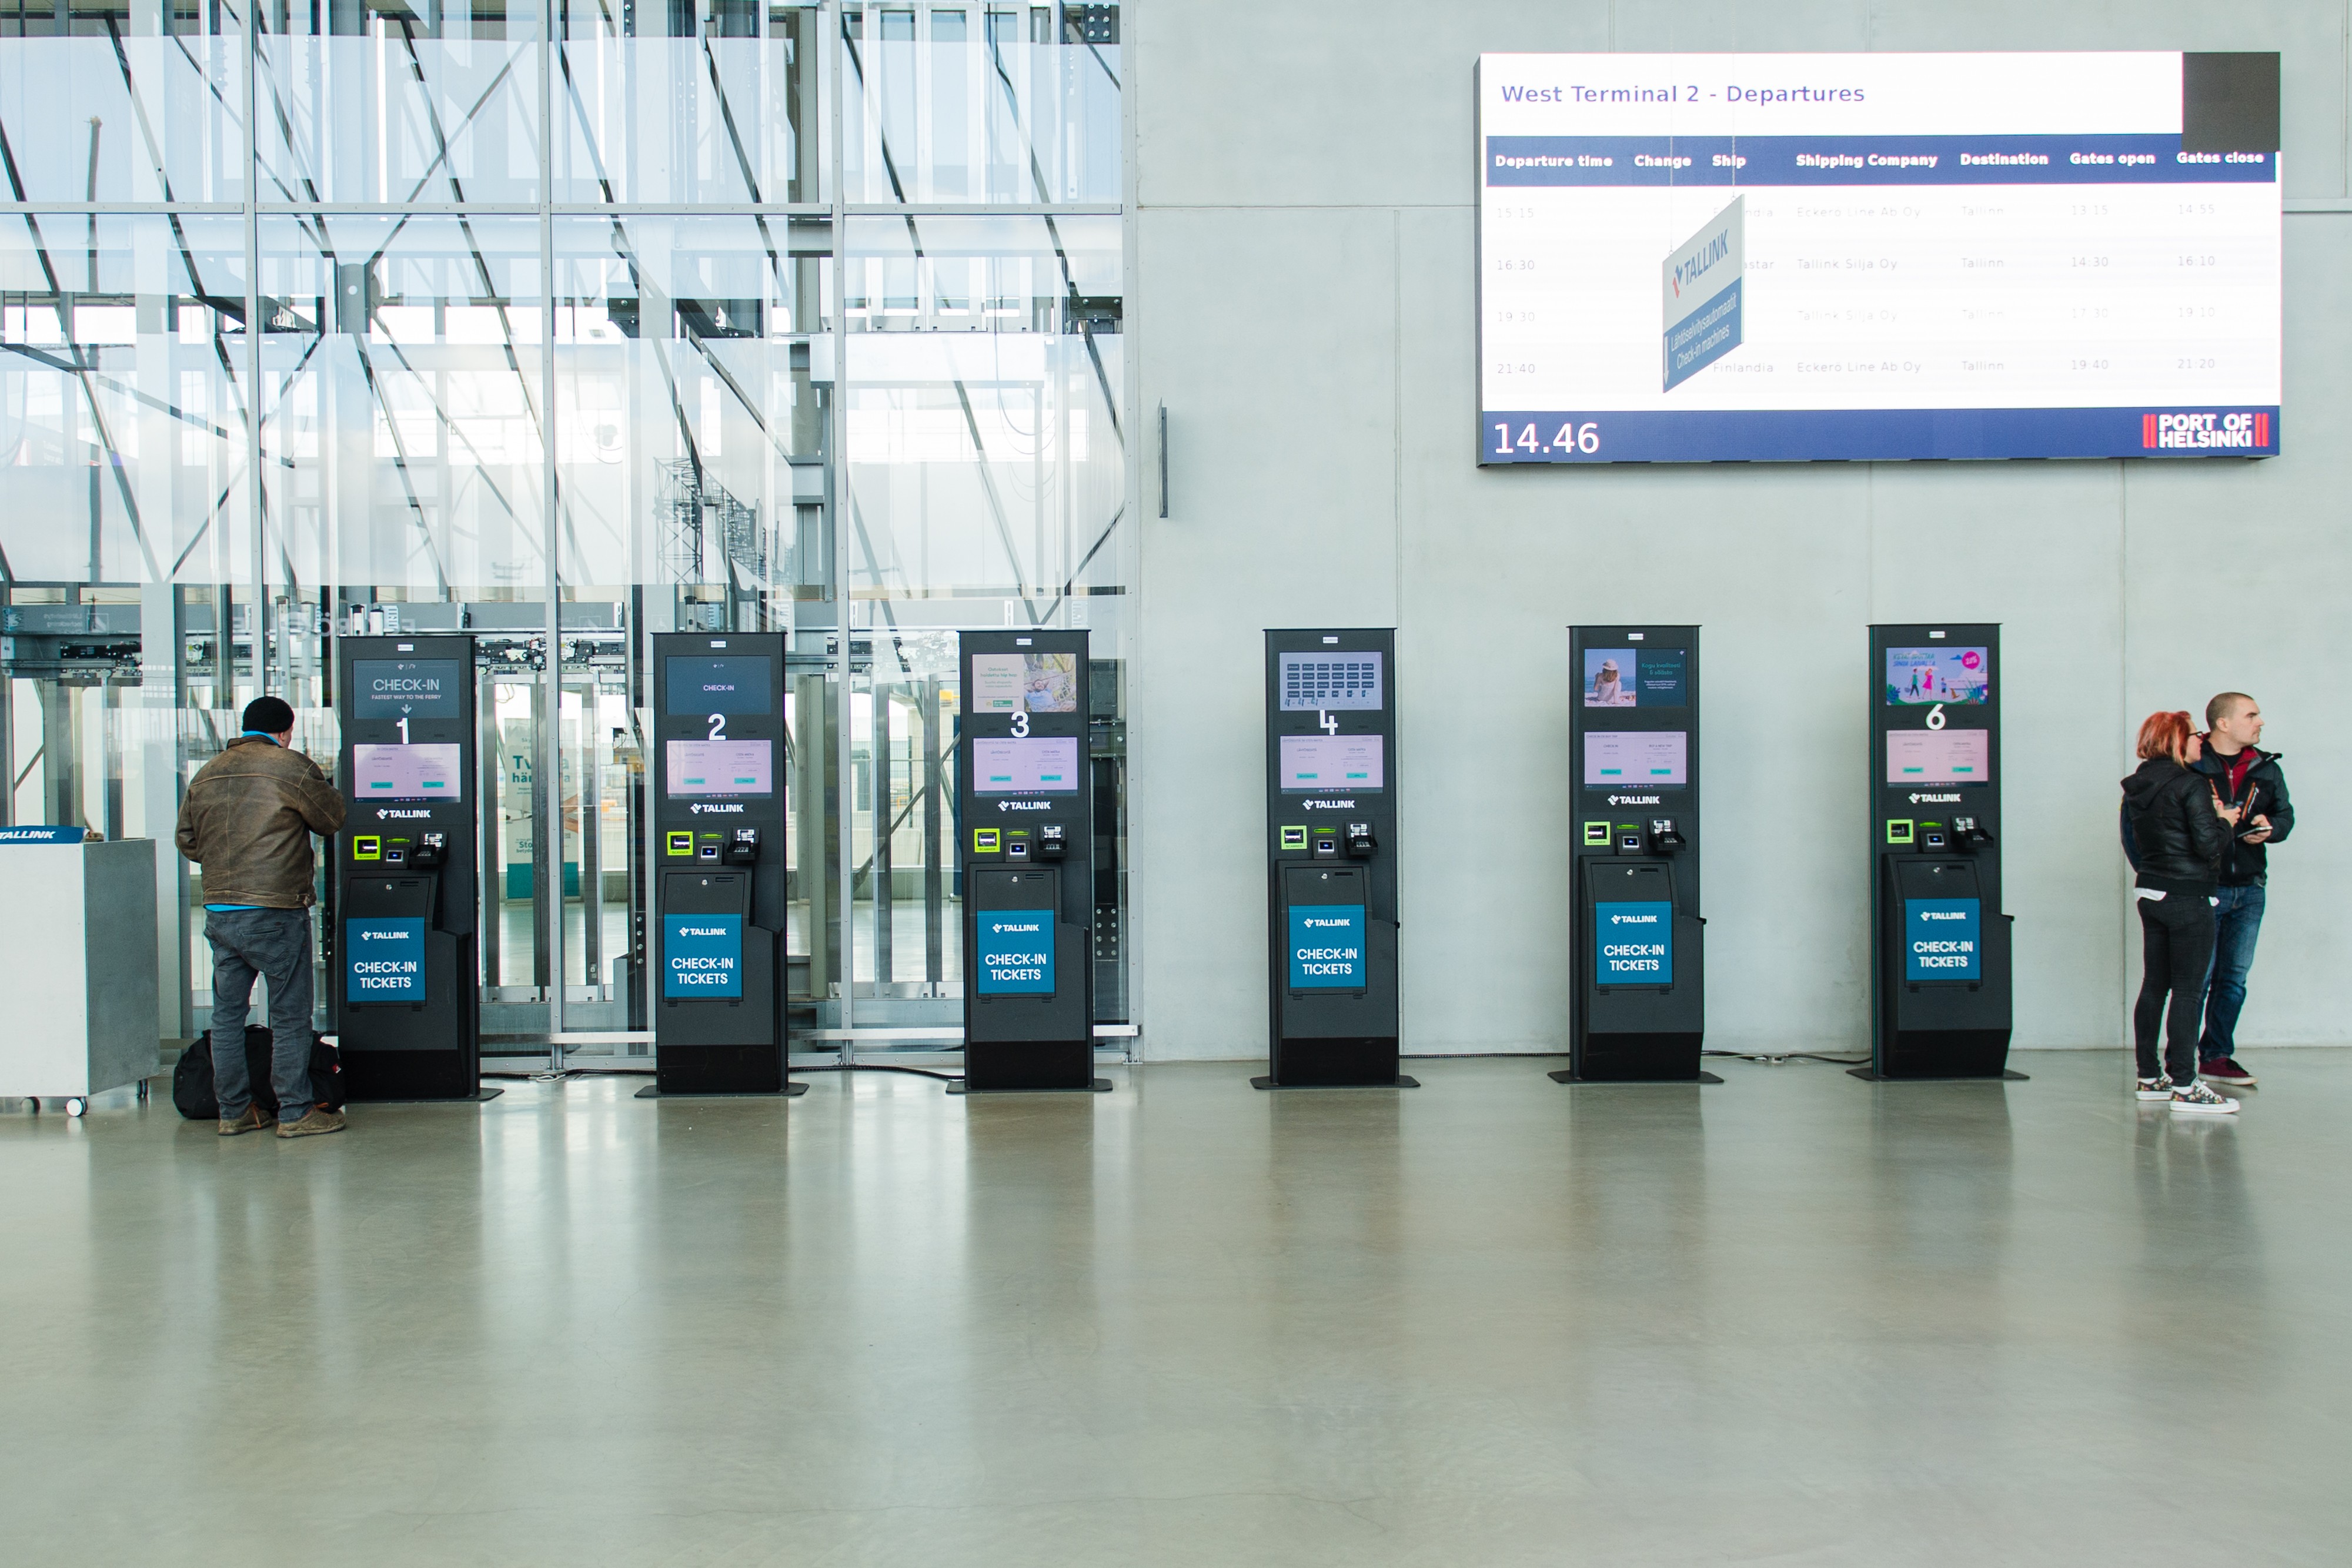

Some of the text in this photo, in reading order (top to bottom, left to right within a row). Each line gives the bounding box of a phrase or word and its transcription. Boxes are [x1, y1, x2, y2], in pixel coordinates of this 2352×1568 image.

[1502, 86, 1562, 102] West
[1571, 85, 1677, 102] Terminal
[1688, 85, 1699, 102] 2
[1728, 85, 1865, 106] Departures
[1495, 155, 1613, 169] Departure time
[1634, 155, 1692, 169] Change
[1712, 155, 1746, 168] Ship
[1796, 153, 1937, 169] Shipping Company
[1960, 153, 2049, 166] Destination
[2070, 153, 2156, 167] Gates open
[2176, 151, 2264, 163] Gates close
[1881, 207, 1897, 217] Ab
[1903, 206, 1921, 219] Oy
[1685, 228, 1729, 286] TALLINK
[1961, 258, 2004, 268] Tallinn
[2071, 256, 2109, 267] 14:30
[2178, 256, 2216, 266] 16:10
[1497, 259, 1535, 270] 16:30
[1797, 258, 1897, 271] Tallink Silja Oy
[1880, 310, 1897, 322] Oy
[1676, 324, 1730, 370] Check-in machines
[1497, 363, 1536, 374] 21:40
[1713, 362, 1773, 373] Finlandia
[1797, 361, 1921, 375] Eckerö Line Ab Oy
[1961, 360, 2004, 370] Tallinn
[2071, 359, 2109, 370] 19:40
[2178, 359, 2216, 369] 21:20
[2159, 413, 2253, 432] PORT OF
[1494, 422, 1600, 454] 14.46
[2159, 430, 2253, 449] HELSINKI
[373, 678, 439, 691] CHECK-IN
[1319, 709, 1338, 735] 4
[1926, 703, 1946, 730] 6
[396, 717, 409, 744] 1
[708, 713, 726, 741] 2
[1010, 711, 1029, 738] 3
[1314, 800, 1355, 808] TALLINK
[1619, 796, 1660, 804] TALLINK
[1920, 794, 1961, 803] TALLINK
[703, 804, 744, 813] TALLINK
[1010, 801, 1051, 810] TALLINK
[389, 810, 431, 818] TALLINK
[1604, 944, 1665, 956] CHECK-IN
[1913, 941, 1973, 952] CHECK-IN
[985, 954, 1046, 965] CHECK-IN
[1297, 948, 1358, 959] CHECK-IN
[354, 961, 417, 973] CHECK-IN
[671, 958, 733, 969] CHECK-IN
[1609, 959, 1659, 971] TICKETS
[1919, 956, 1968, 967] TICKETS
[991, 969, 1041, 980] TICKETS
[1302, 963, 1352, 975] TICKETS
[360, 977, 412, 988] TICKETS
[677, 973, 728, 984] TICKETS
